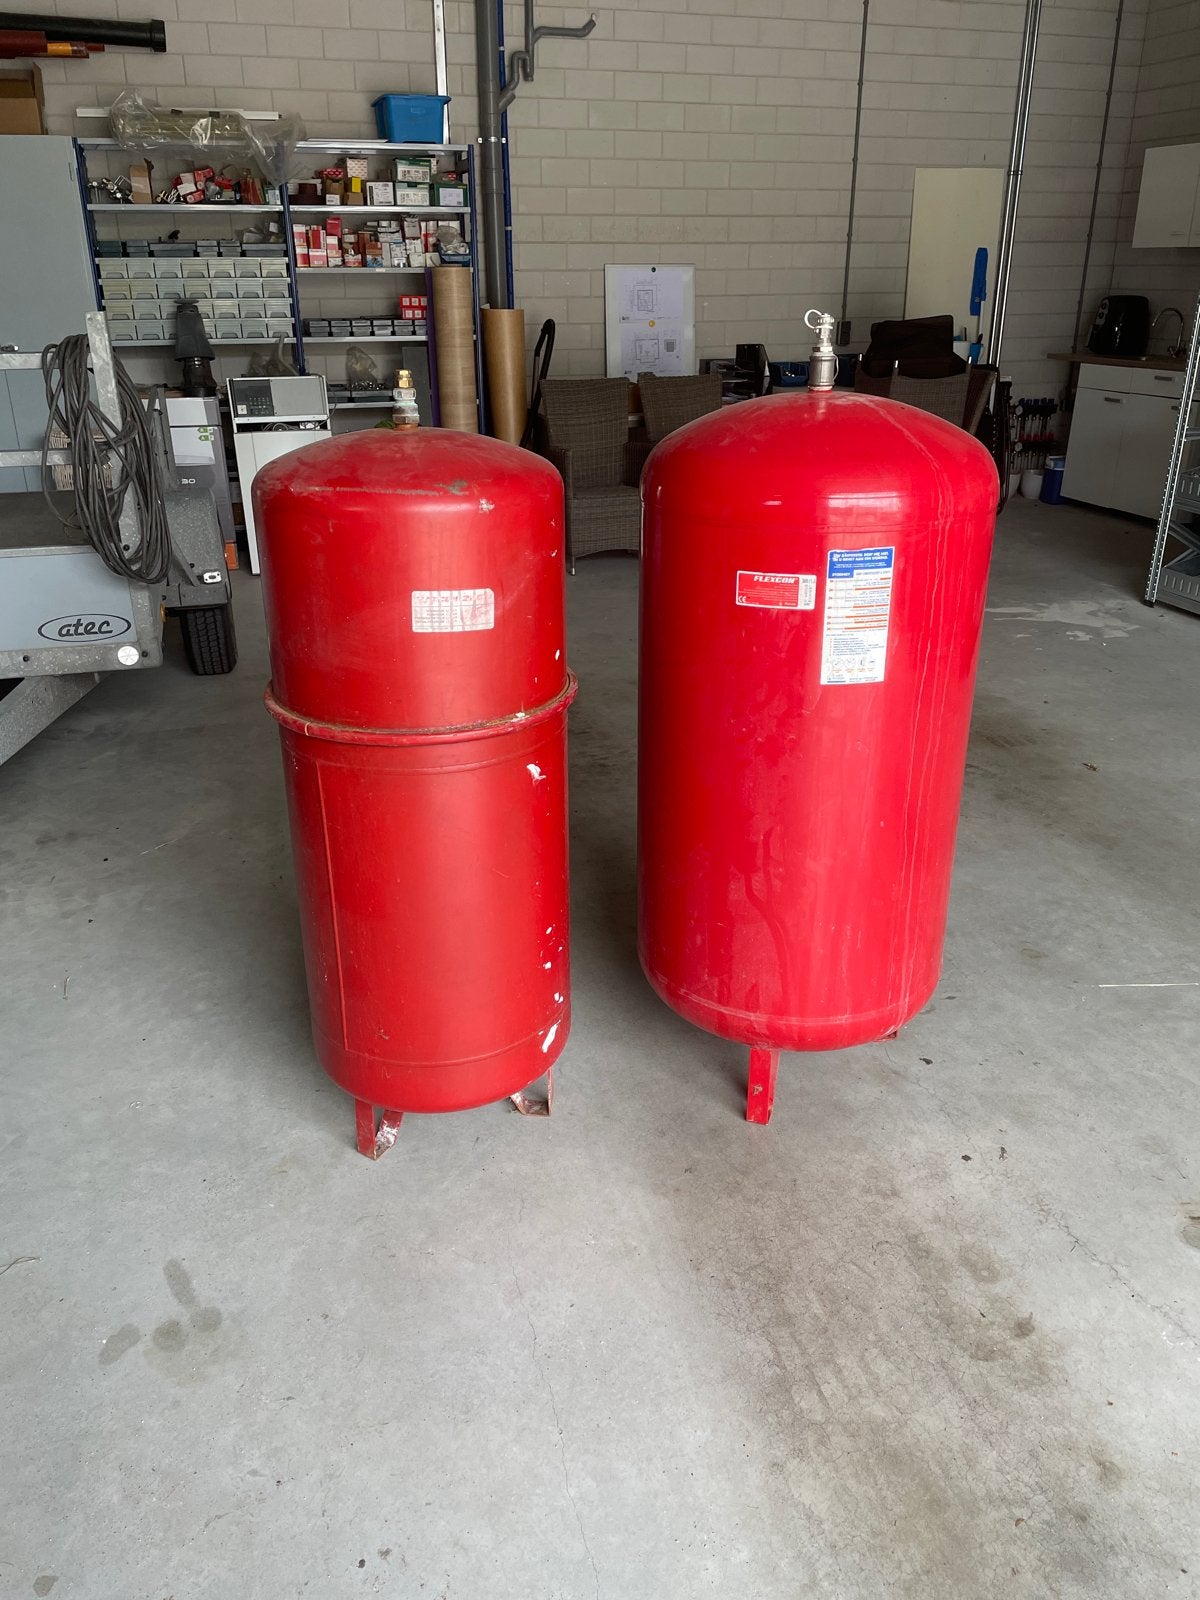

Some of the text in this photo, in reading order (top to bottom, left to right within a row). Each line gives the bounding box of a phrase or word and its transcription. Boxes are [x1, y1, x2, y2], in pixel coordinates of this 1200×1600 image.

[753, 576, 796, 584] FLEXCON
[738, 595, 747, 603] CE
[58, 618, 114, 637] atec
